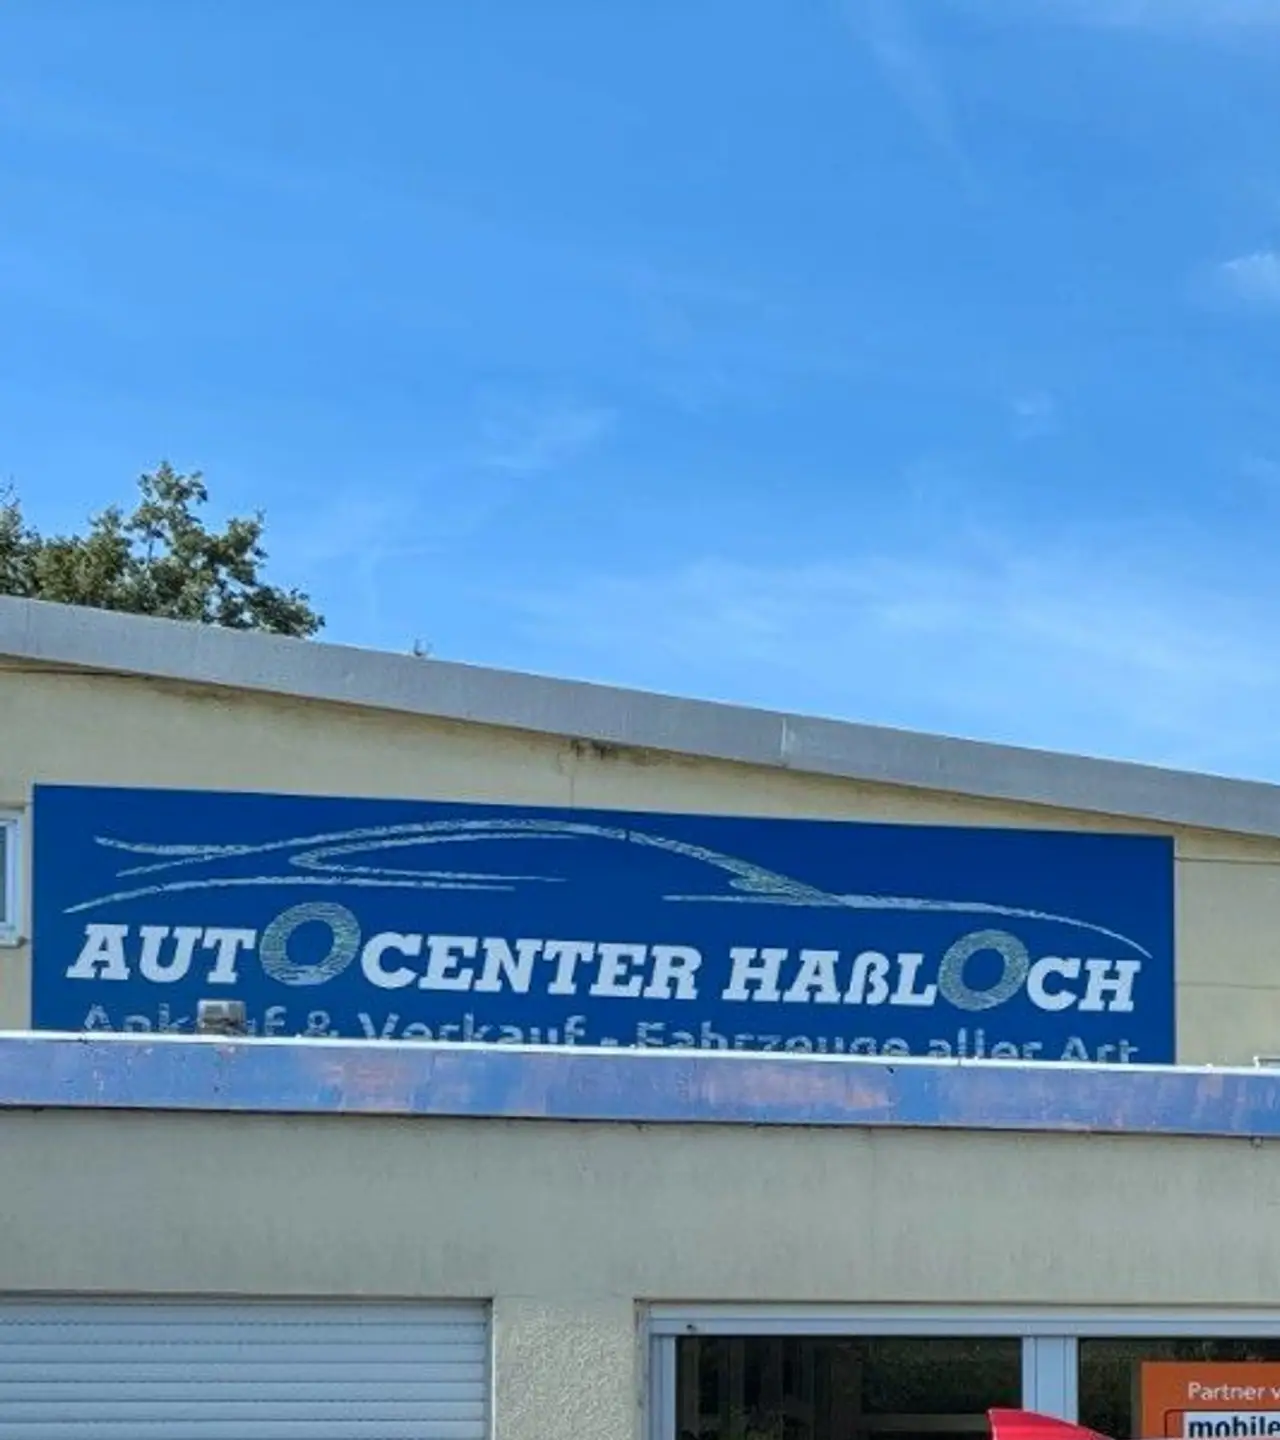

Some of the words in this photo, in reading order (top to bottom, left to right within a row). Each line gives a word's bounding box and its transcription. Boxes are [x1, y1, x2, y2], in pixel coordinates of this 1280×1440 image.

[66, 902, 702, 1000] AUTOCENTER
[722, 929, 1142, 1012] HAßLOCH
[1060, 1036, 1139, 1063] Art
[1188, 1381, 1265, 1400] Partner
